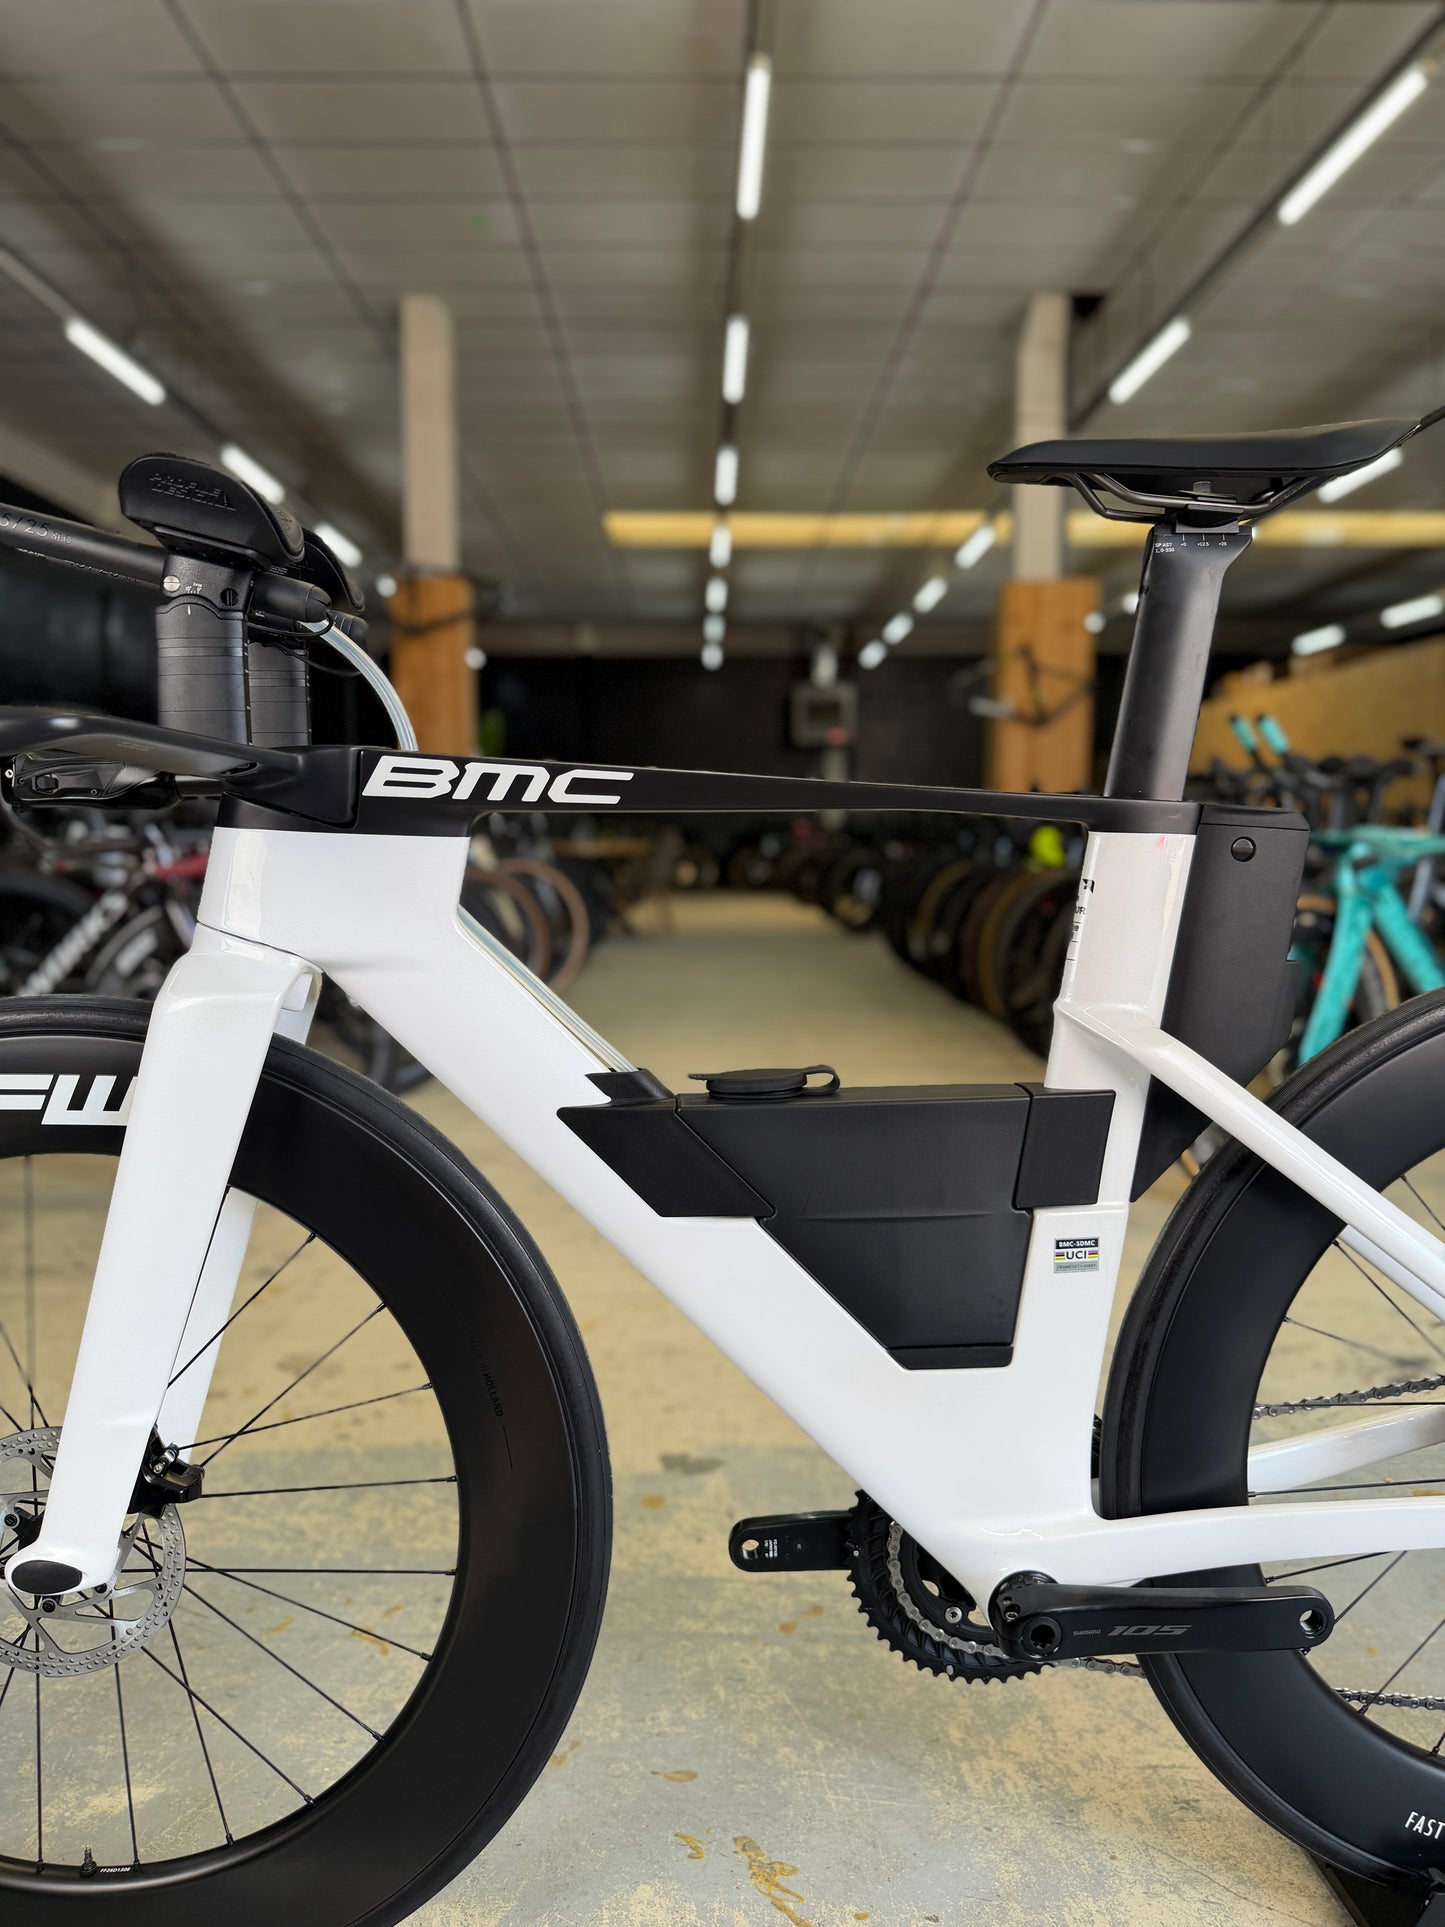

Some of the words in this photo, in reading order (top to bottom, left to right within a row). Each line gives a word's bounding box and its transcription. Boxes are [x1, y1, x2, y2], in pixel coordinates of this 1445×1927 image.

[362, 755, 634, 805] BMC
[1066, 1250, 1087, 1260] UCI
[482, 1371, 504, 1417] HOLLAND
[1108, 1624, 1192, 1637] 105
[1404, 1811, 1445, 1840] FAST
